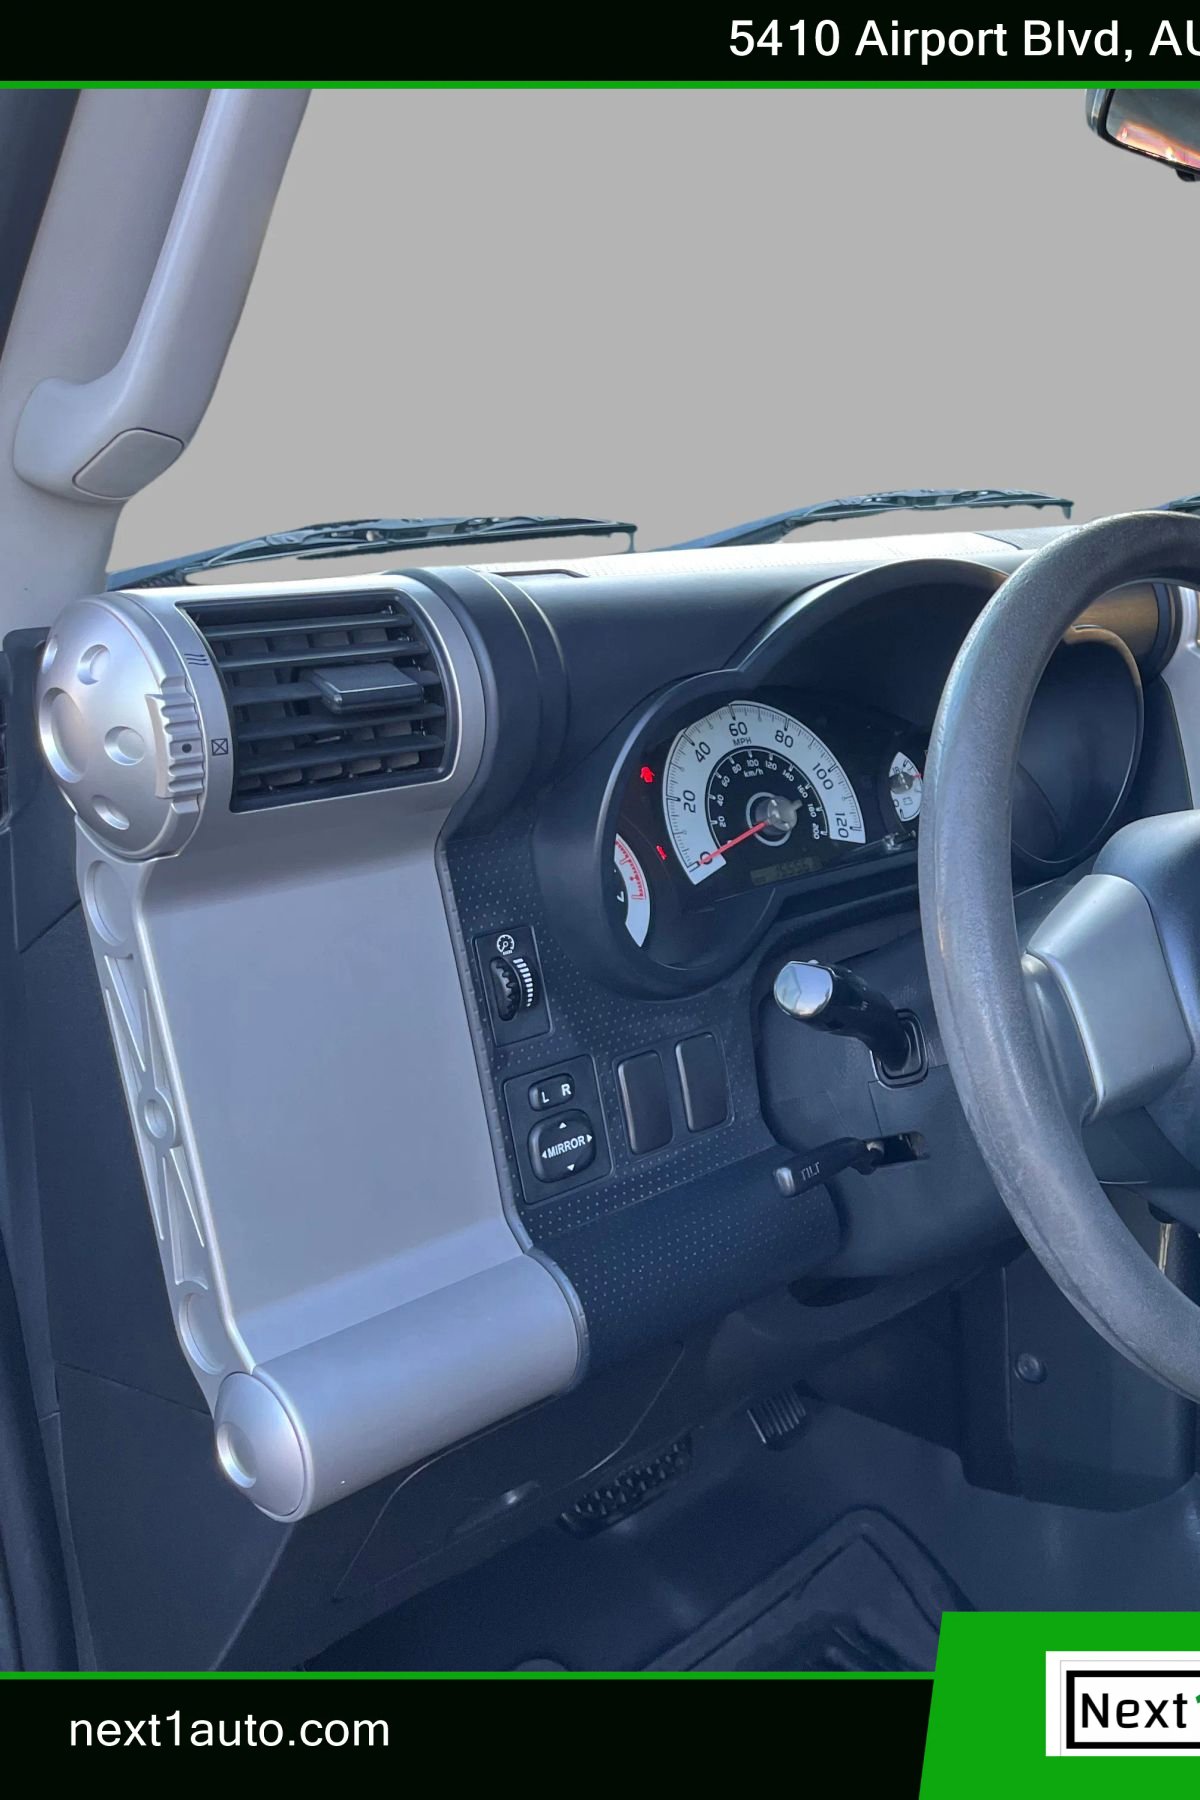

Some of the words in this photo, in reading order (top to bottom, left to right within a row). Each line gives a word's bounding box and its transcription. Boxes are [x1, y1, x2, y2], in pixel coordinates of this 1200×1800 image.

[729, 721, 748, 737] 60
[774, 729, 794, 749] 80
[732, 736, 752, 747] MPH
[693, 741, 711, 763] 40
[746, 758, 760, 767] 100
[765, 760, 778, 771] 120
[743, 768, 764, 778] km/h
[812, 762, 834, 791] 100
[682, 789, 696, 814] 20
[835, 812, 849, 839] 120
[541, 1091, 550, 1104] L
[561, 1083, 572, 1097] R
[547, 1135, 586, 1158] MIRROR
[801, 1161, 820, 1181] TILT
